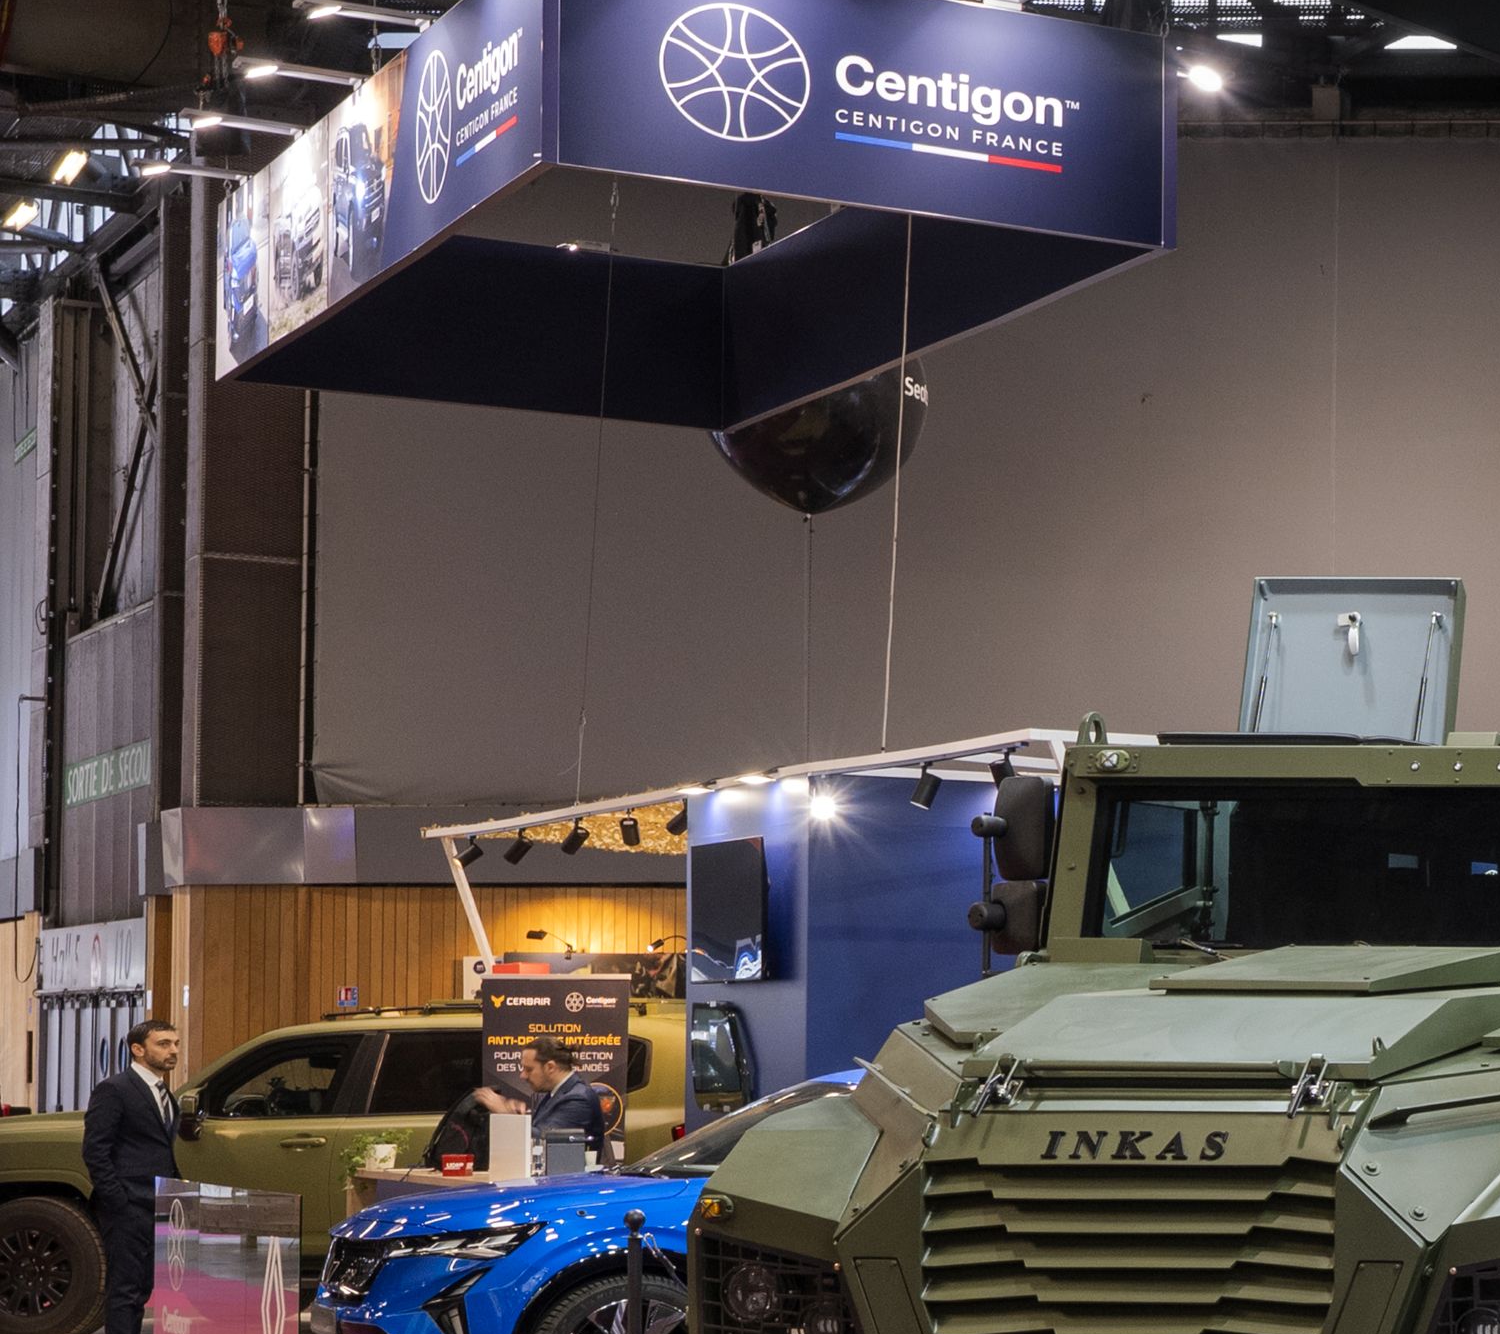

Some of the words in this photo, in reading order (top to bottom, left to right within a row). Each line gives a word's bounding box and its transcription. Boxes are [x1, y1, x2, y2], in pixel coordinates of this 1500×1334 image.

[455, 109, 489, 147] CENTIGON
[490, 87, 518, 120] FRANCE
[835, 108, 960, 141] CENTIGON
[972, 130, 1063, 157] FRANCE
[67, 761, 98, 805] SORTIE
[101, 755, 114, 795] DE
[528, 1023, 582, 1033] SOLUTION
[494, 1051, 521, 1060] POUR
[496, 1064, 517, 1072] DES
[1040, 1130, 1230, 1162] INKAS
